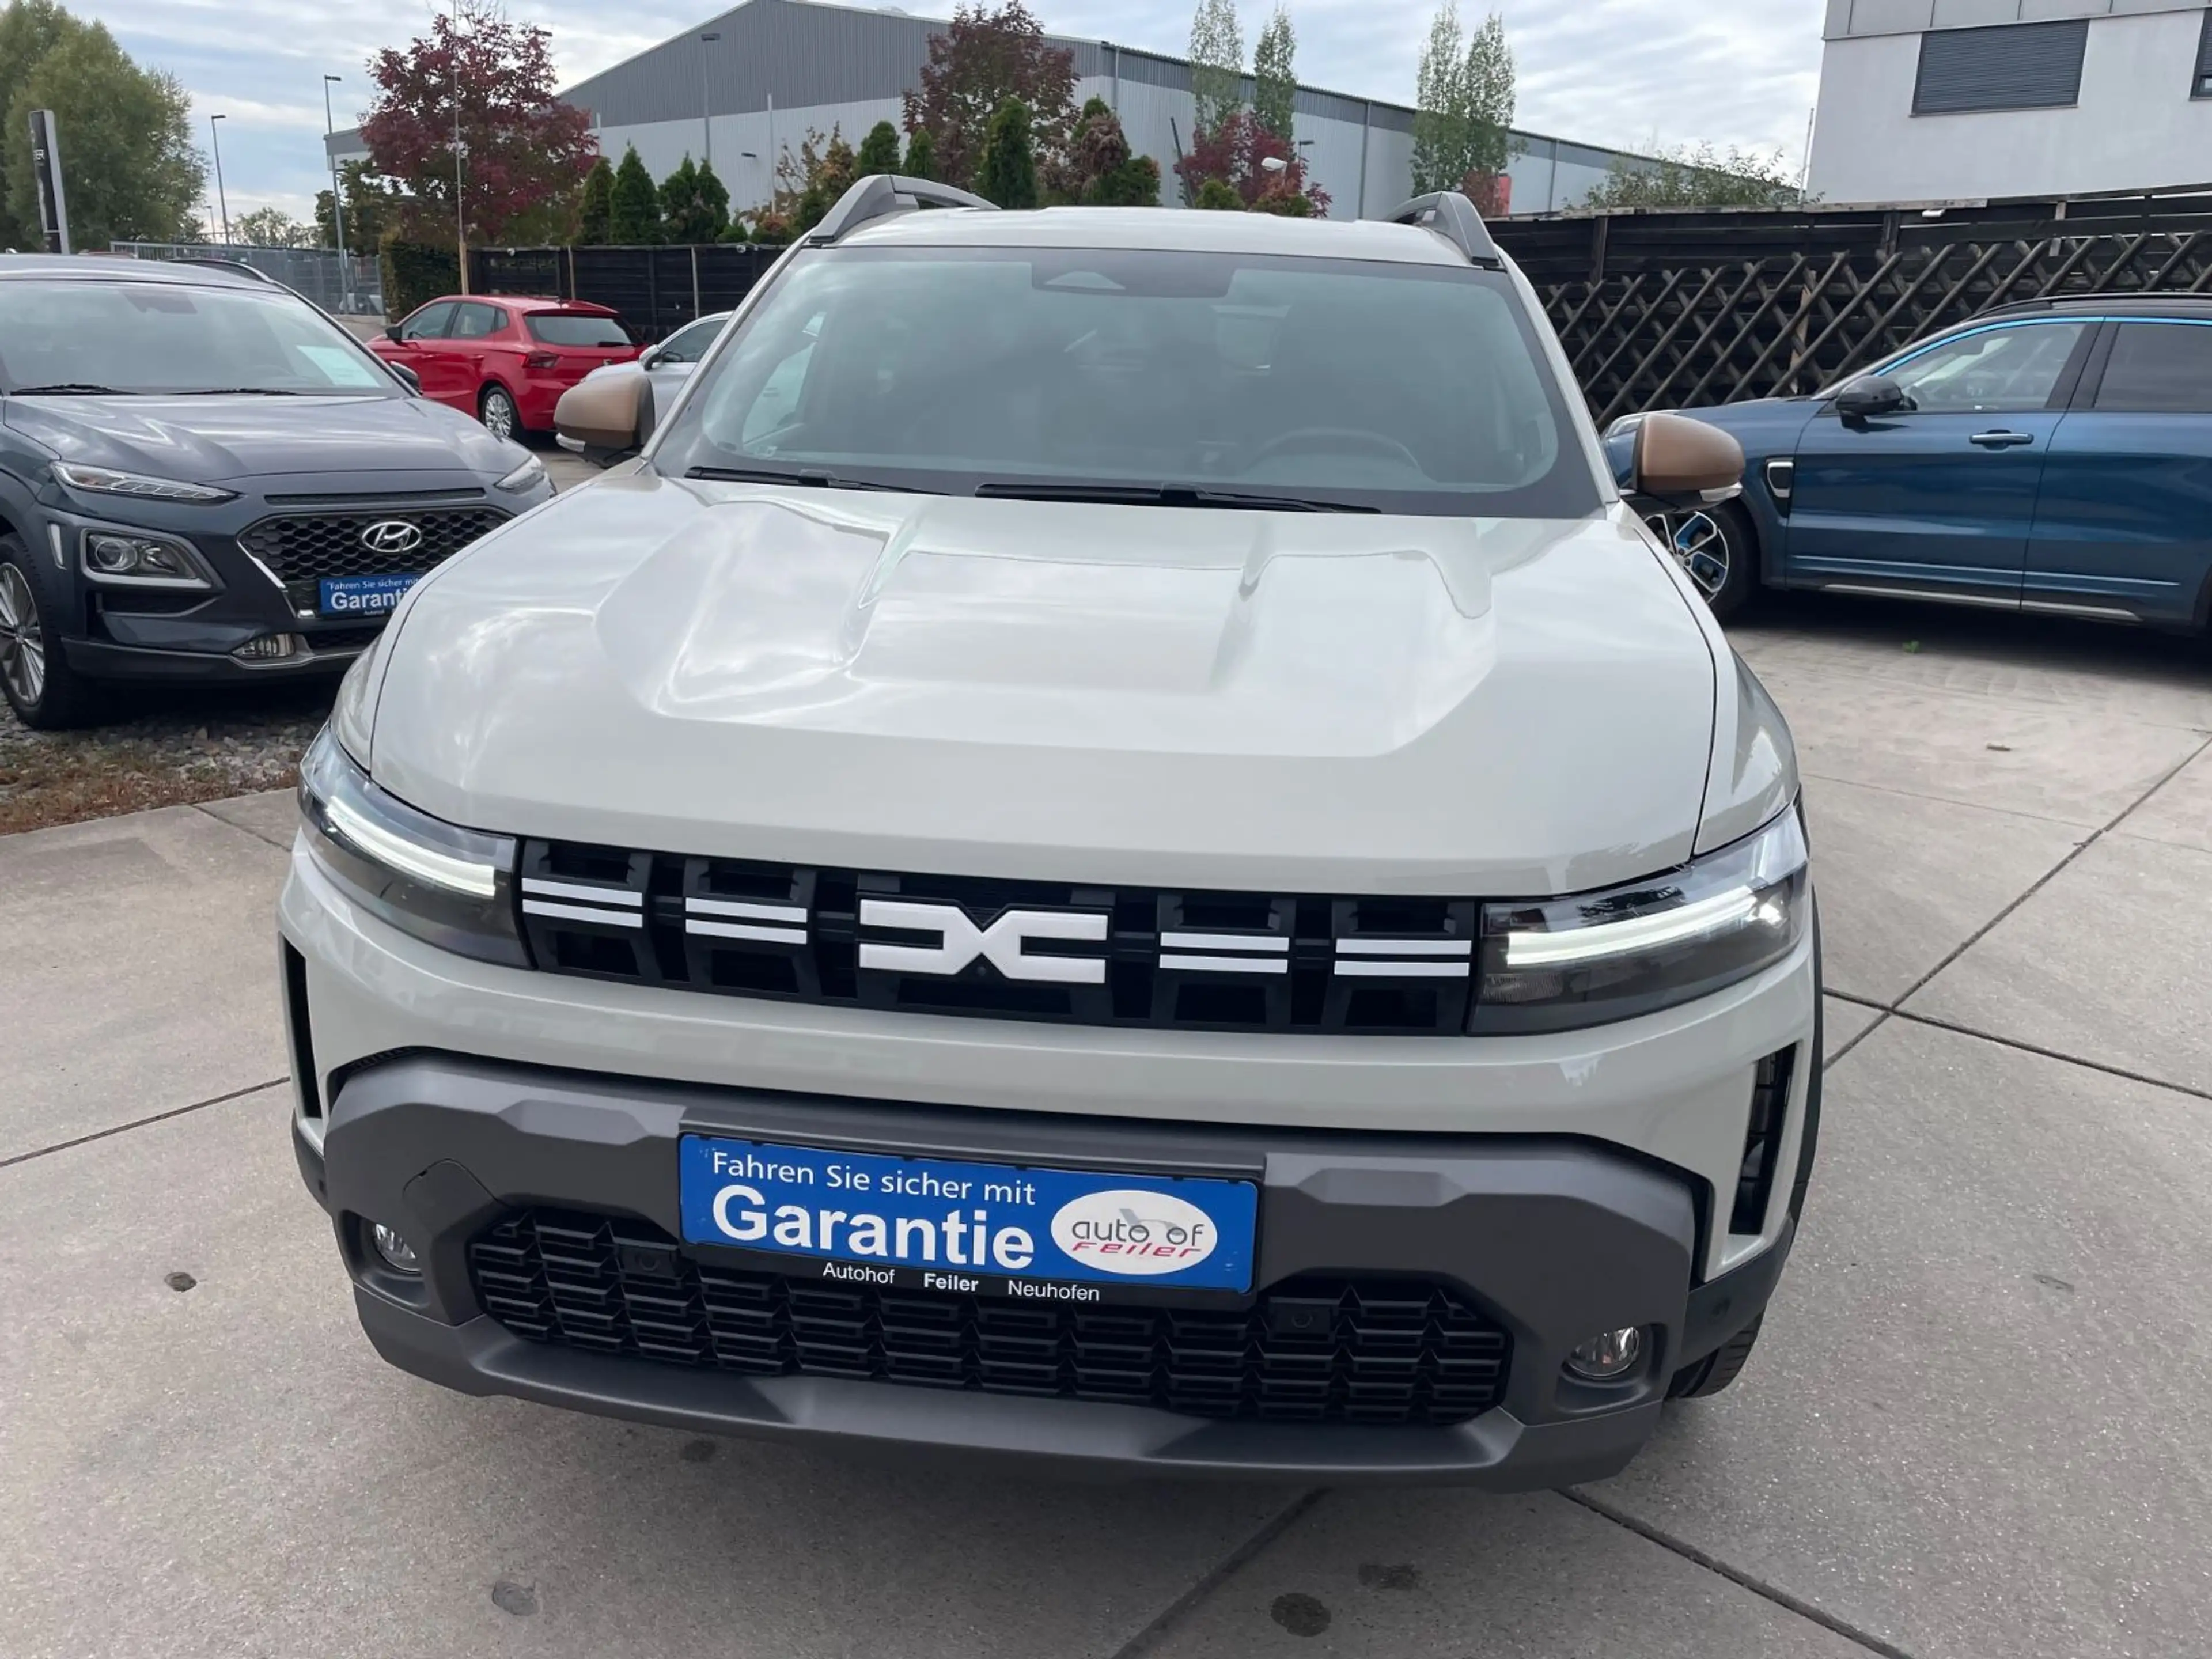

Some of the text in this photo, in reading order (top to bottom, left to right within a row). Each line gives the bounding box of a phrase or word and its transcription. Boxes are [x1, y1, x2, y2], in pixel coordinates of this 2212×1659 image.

[362, 580, 375, 588] Sie
[378, 578, 403, 588] sicher
[713, 1151, 1036, 1206] Fahren Sie sicher mit
[712, 1184, 1035, 1269] Garantie
[822, 1262, 1100, 1302] Autohof Feiler Neuhofen
